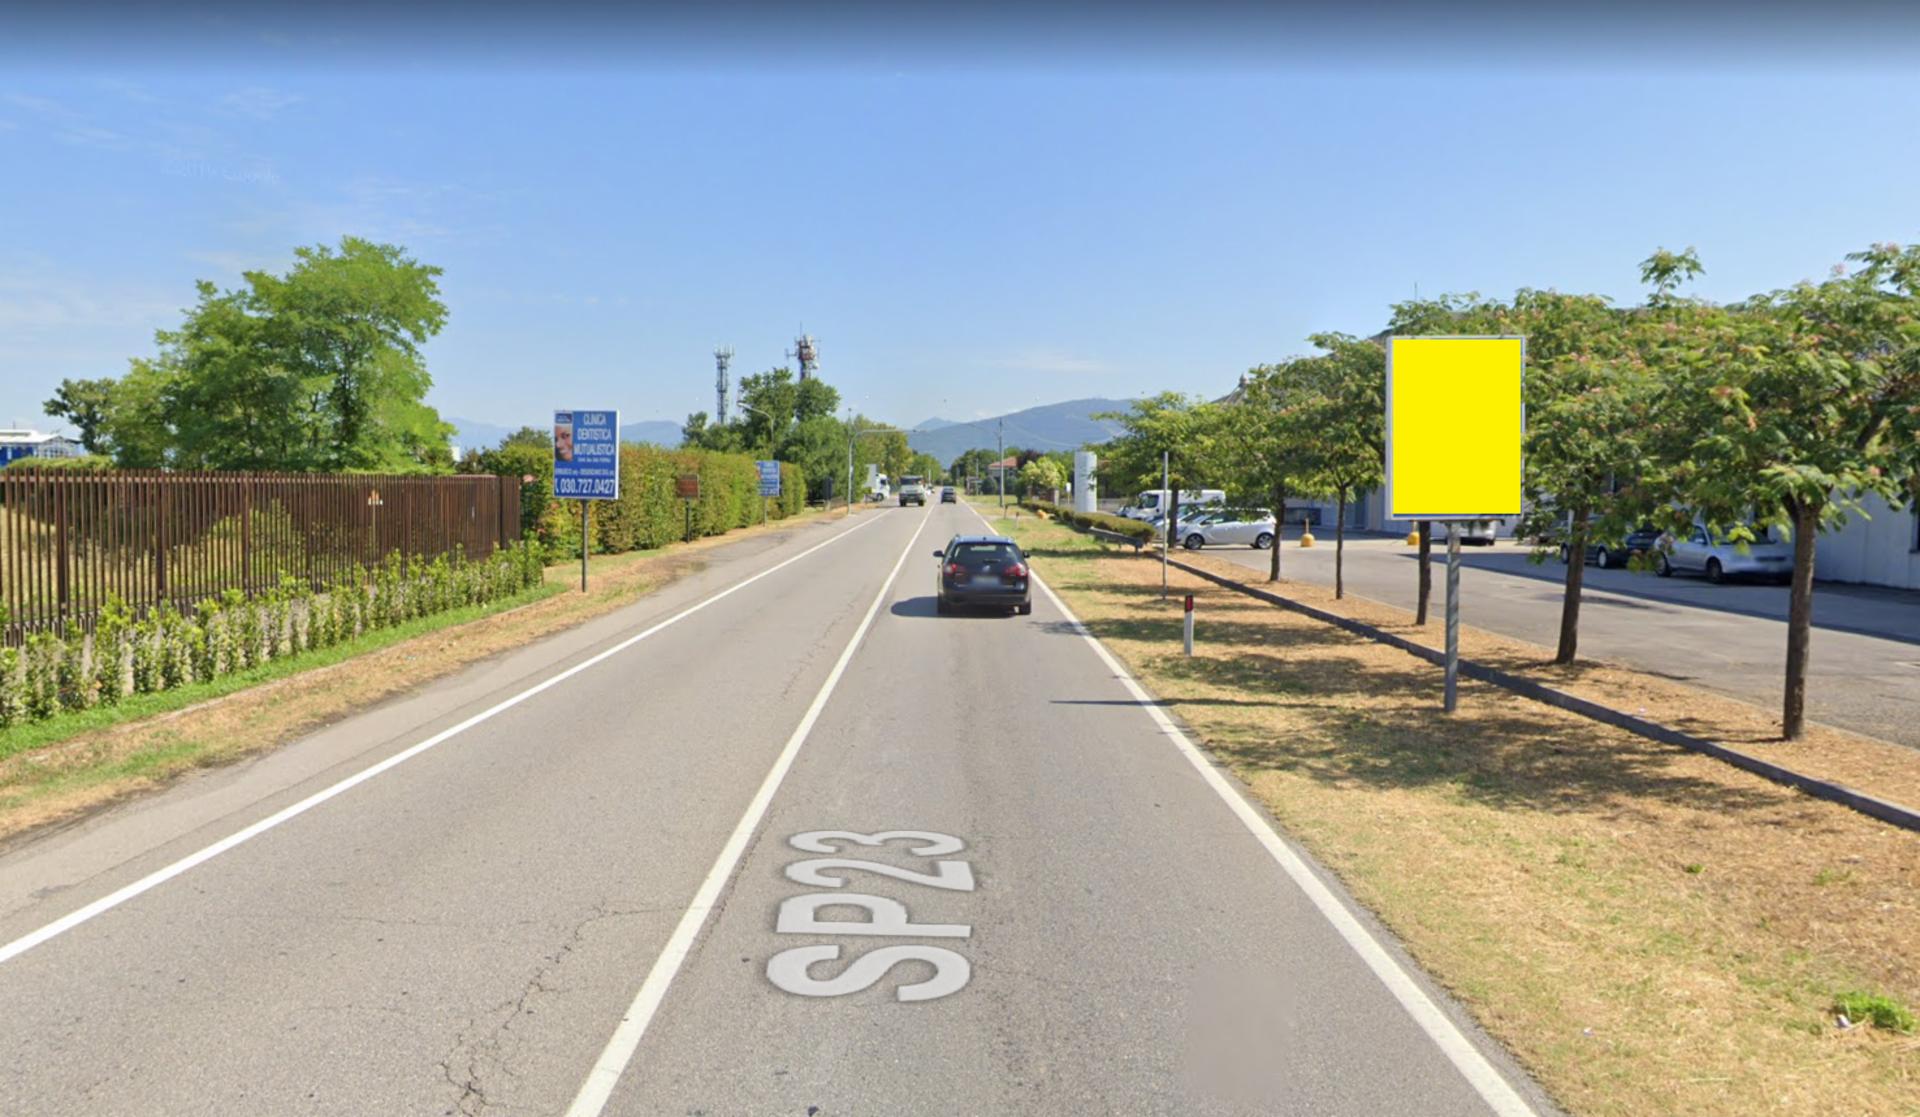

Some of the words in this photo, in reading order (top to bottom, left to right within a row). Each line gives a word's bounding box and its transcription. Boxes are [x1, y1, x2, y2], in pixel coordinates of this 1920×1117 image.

[583, 413, 607, 425] CLINICA
[577, 428, 612, 440] DENTISTICA
[574, 443, 614, 455] MUTUALISTICA
